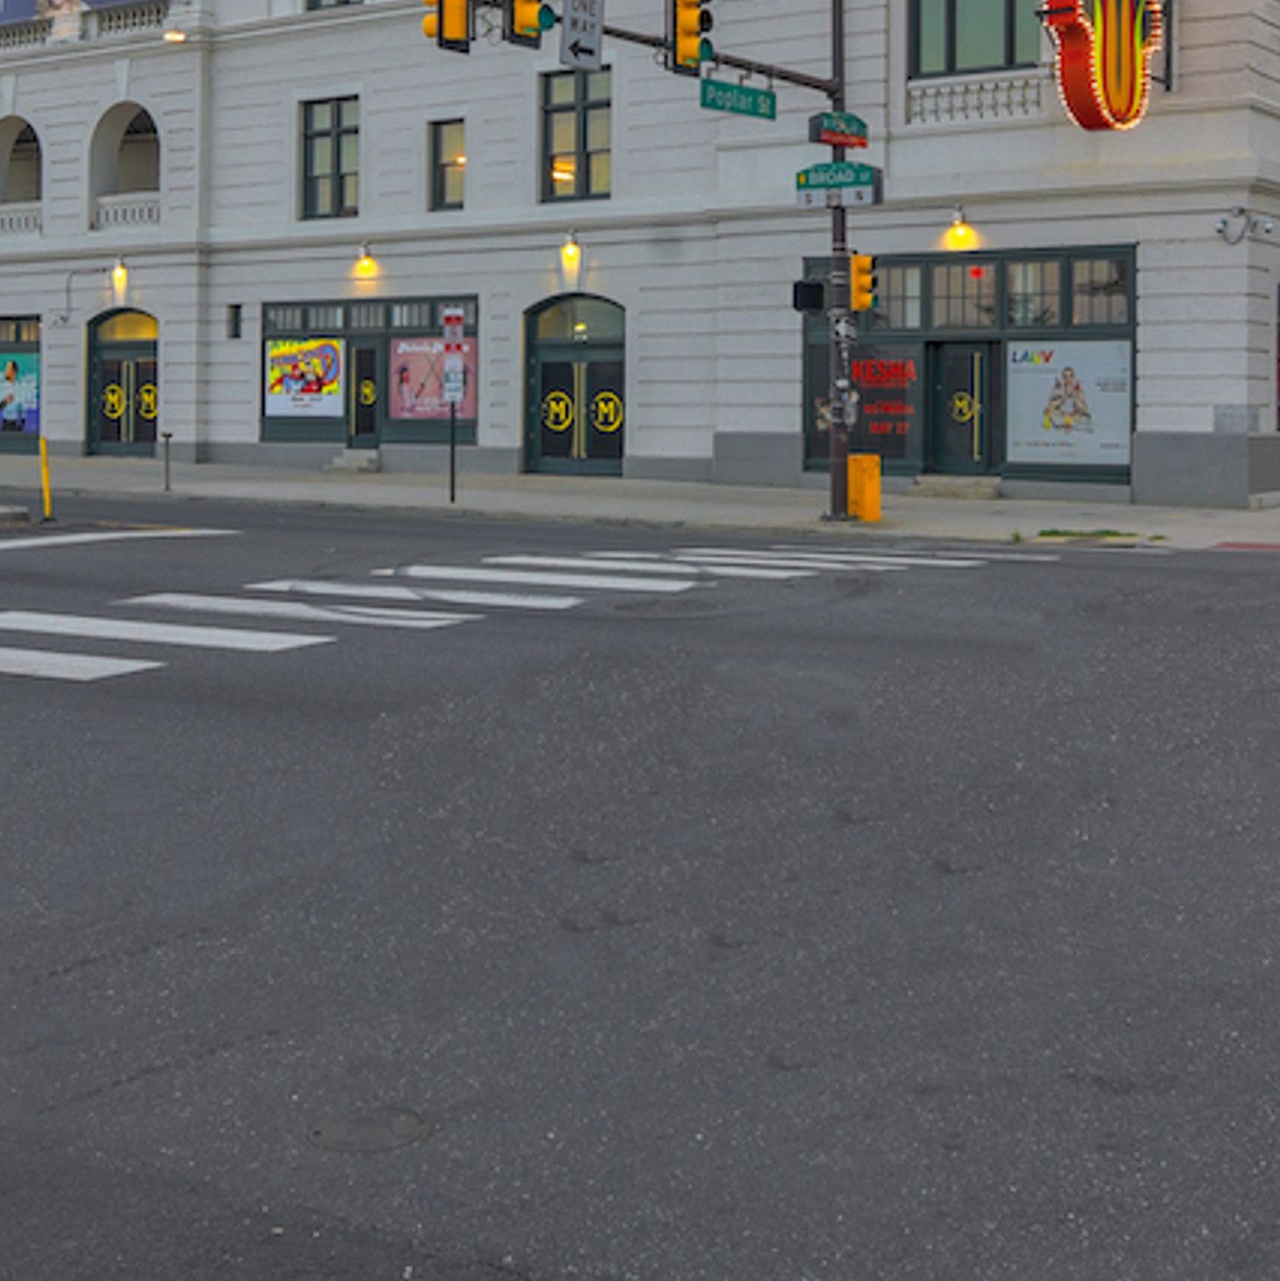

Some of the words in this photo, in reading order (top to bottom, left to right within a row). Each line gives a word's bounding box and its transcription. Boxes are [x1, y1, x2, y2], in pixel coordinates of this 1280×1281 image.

[570, 17, 597, 34] WAY
[706, 85, 754, 110] Poplar
[757, 94, 771, 113] St
[807, 168, 855, 185] BROAD
[850, 358, 917, 383] KESHA
